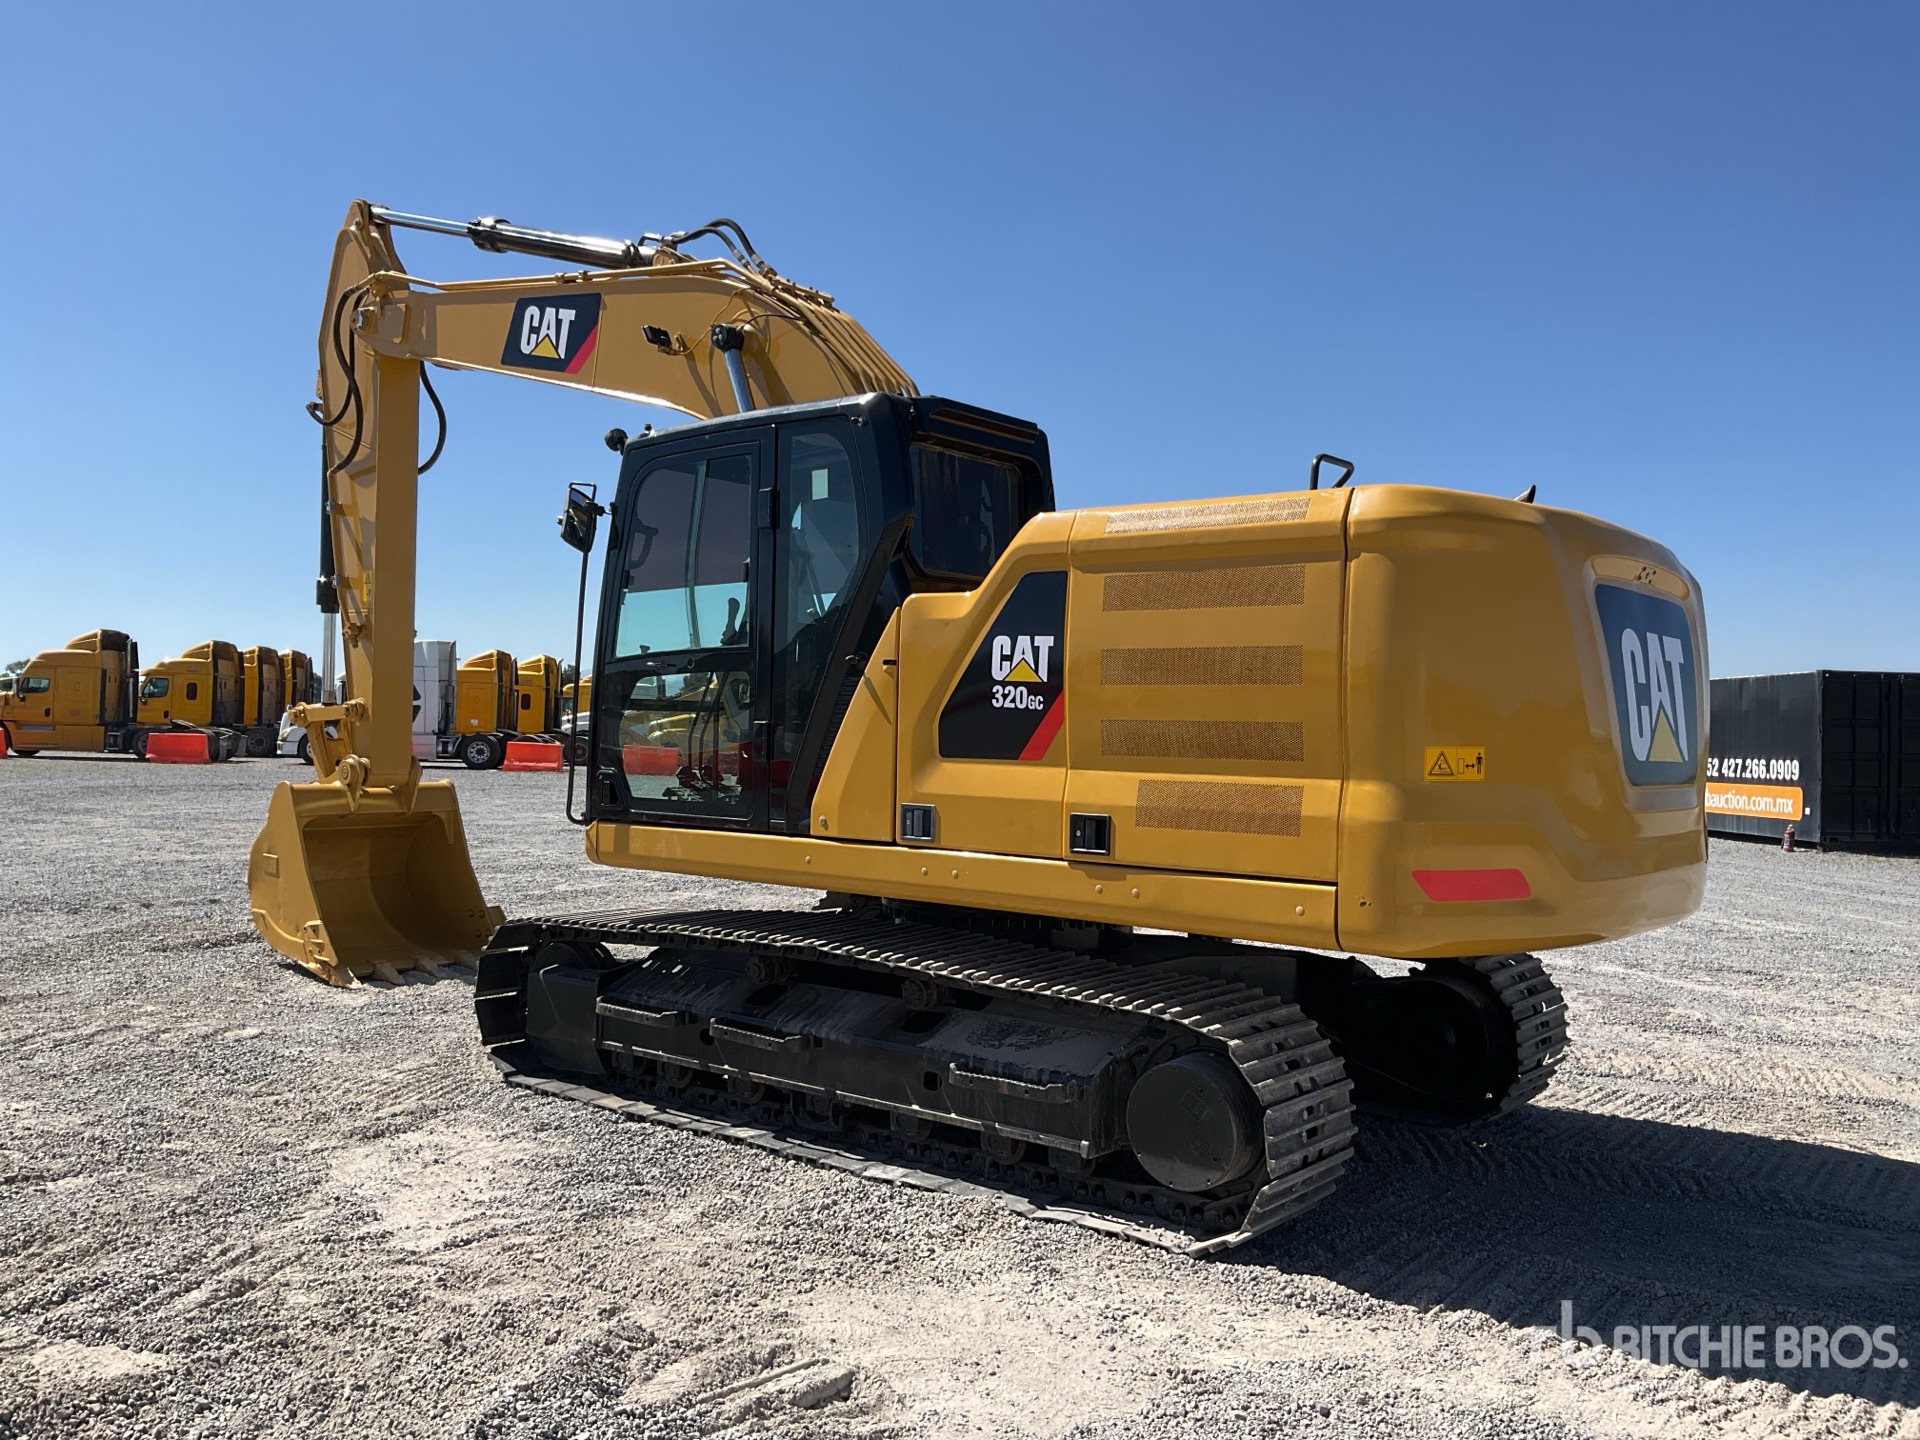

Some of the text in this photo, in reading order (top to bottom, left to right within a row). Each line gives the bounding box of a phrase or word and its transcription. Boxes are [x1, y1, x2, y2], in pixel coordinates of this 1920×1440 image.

[520, 305, 576, 360] CAT
[991, 635, 1055, 683] CAT
[1621, 628, 1689, 763] CAT
[1721, 758, 1800, 781] 427.266.0909
